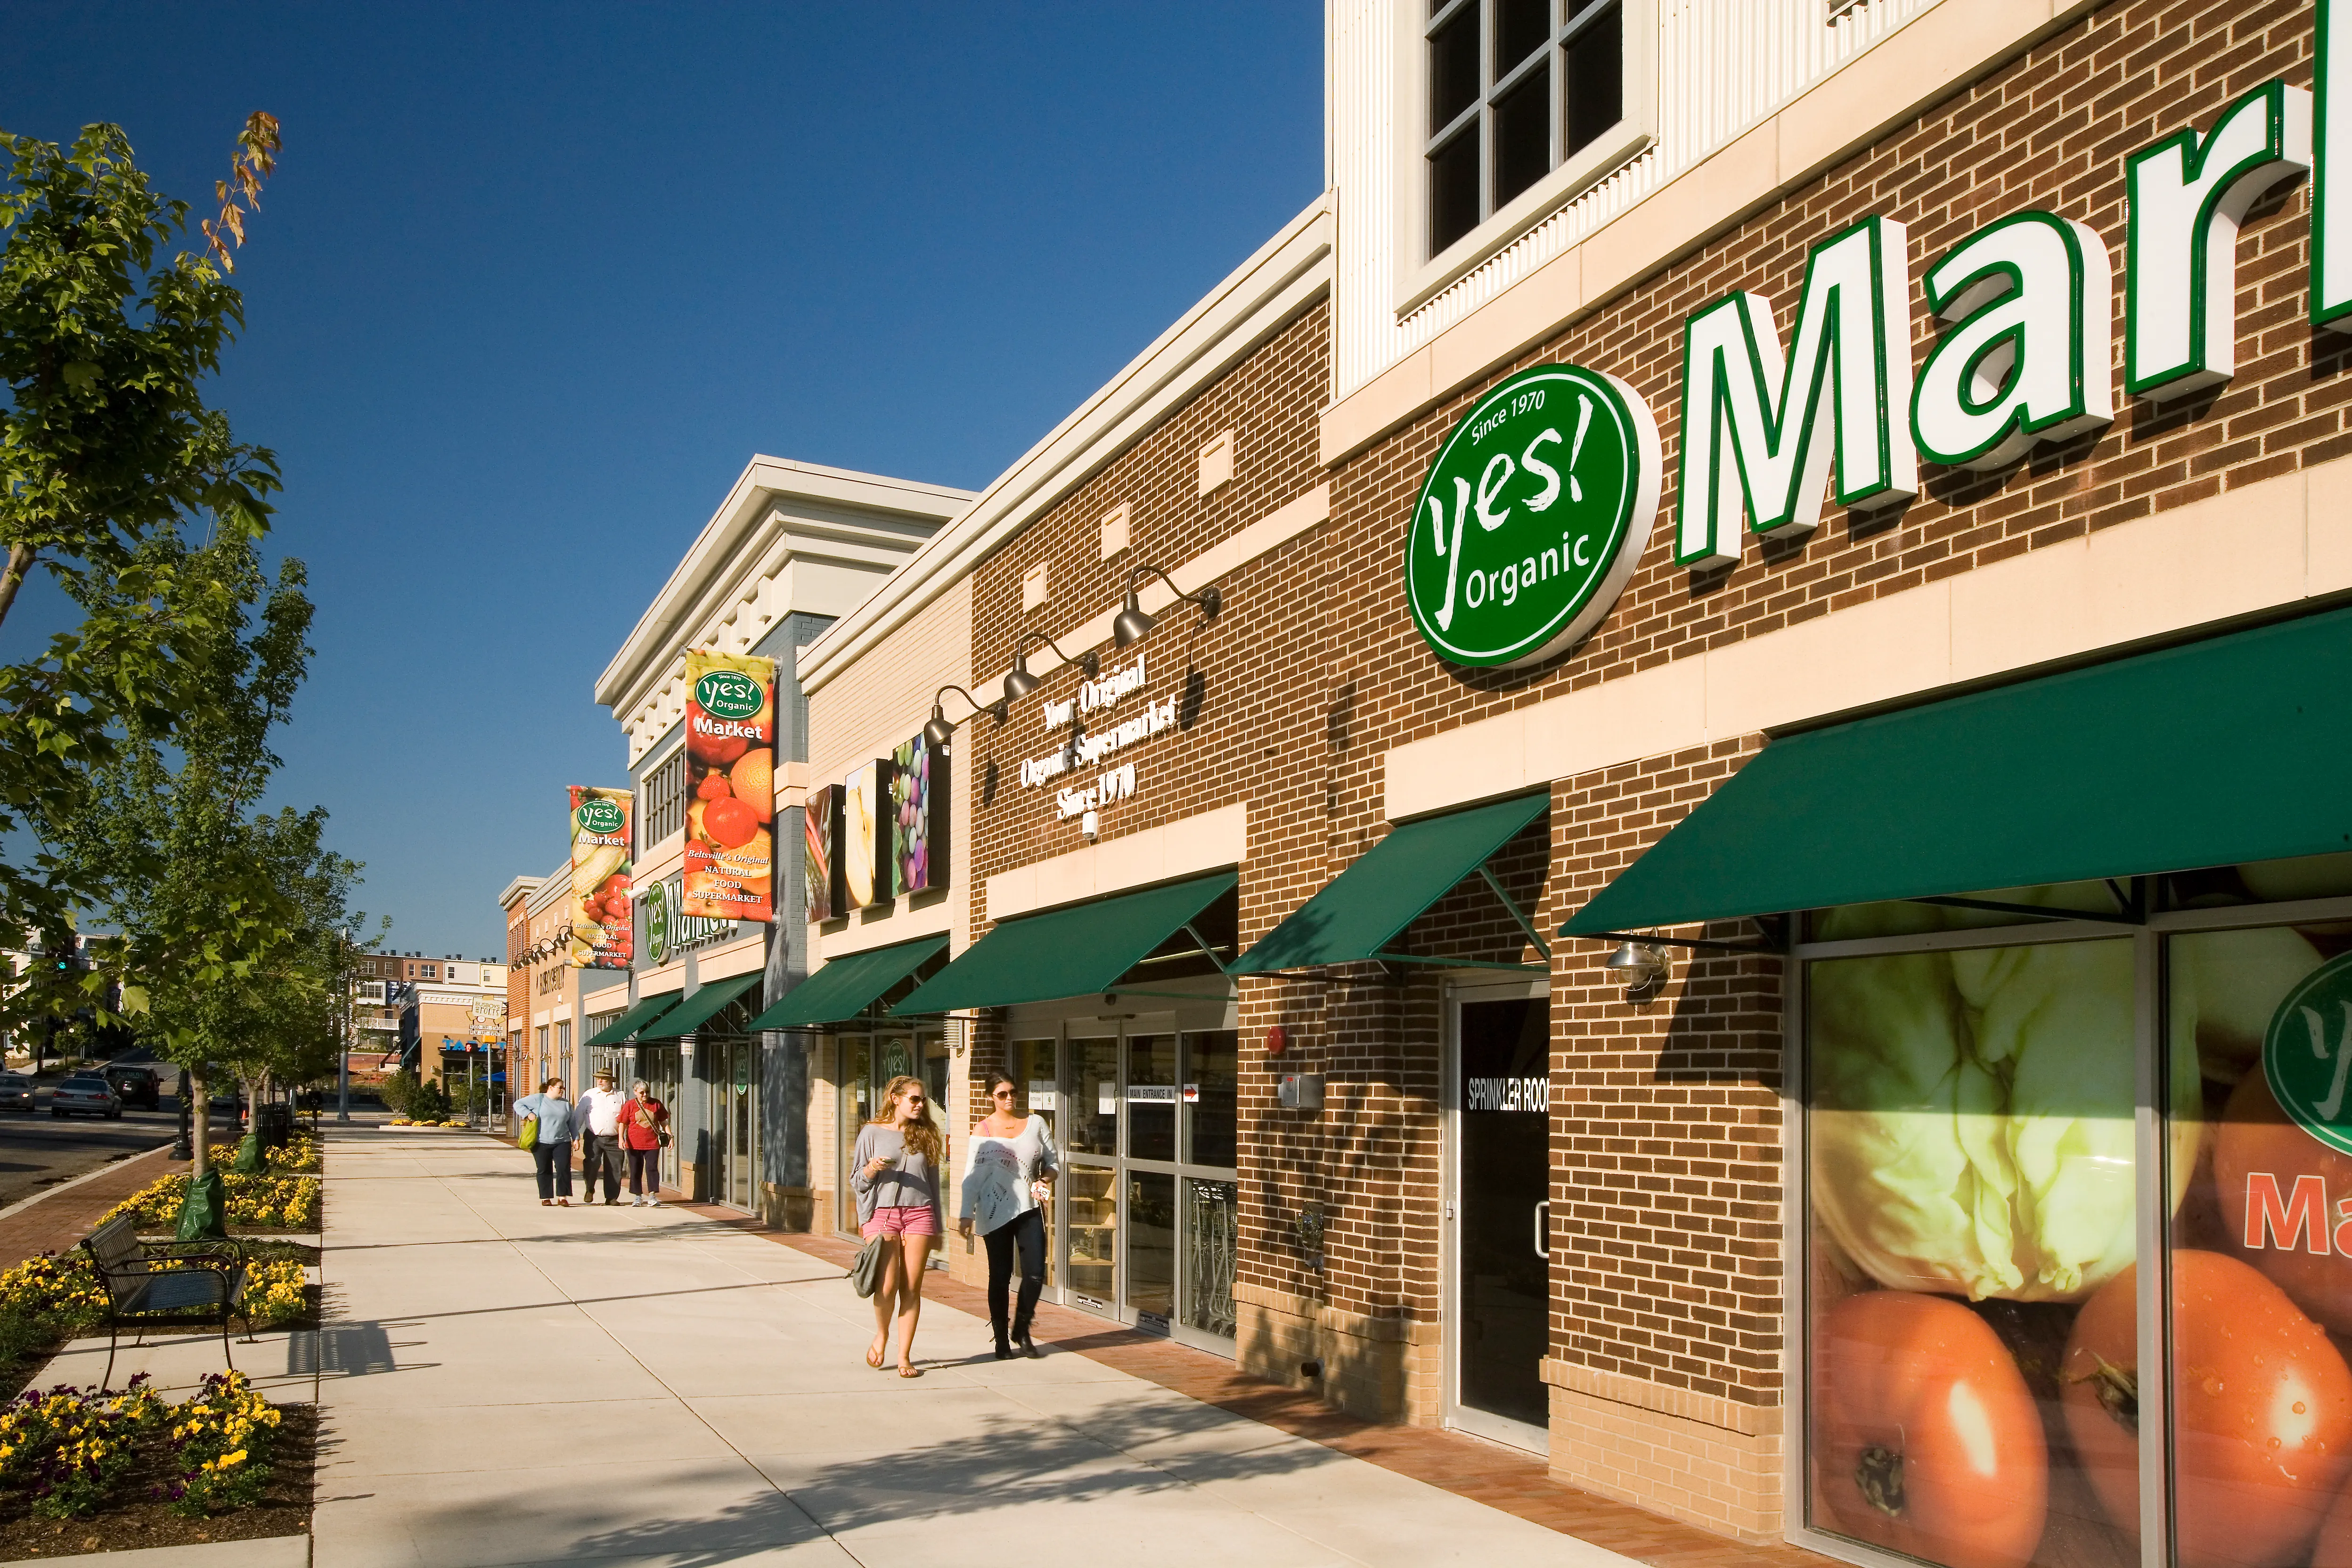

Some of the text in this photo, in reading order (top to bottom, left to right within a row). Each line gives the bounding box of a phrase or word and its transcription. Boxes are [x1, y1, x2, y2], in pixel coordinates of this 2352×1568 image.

[1471, 389, 1546, 446] Since 1970
[1428, 393, 1594, 633] yes!
[1466, 531, 1590, 609] Organic
[703, 680, 754, 708] yes!
[1043, 653, 1147, 731] Your Original
[716, 700, 753, 711] Organic
[695, 718, 763, 740] Market
[1021, 694, 1177, 788] Organic Supermarket
[1057, 762, 1136, 820] Since 1970
[582, 807, 619, 826] yes!
[578, 833, 625, 846] Market
[688, 849, 769, 865] Beltsville's Original
[705, 866, 751, 877] NATURAL
[714, 879, 742, 889] FOOD
[692, 890, 763, 904] SUPERMARKET
[648, 893, 663, 949] yes!
[475, 1001, 500, 1010] BUSBOYS
[1130, 1089, 1172, 1099] MAIN ENTRANCE IN
[1468, 1077, 1550, 1112] SPRINKLER ROO
